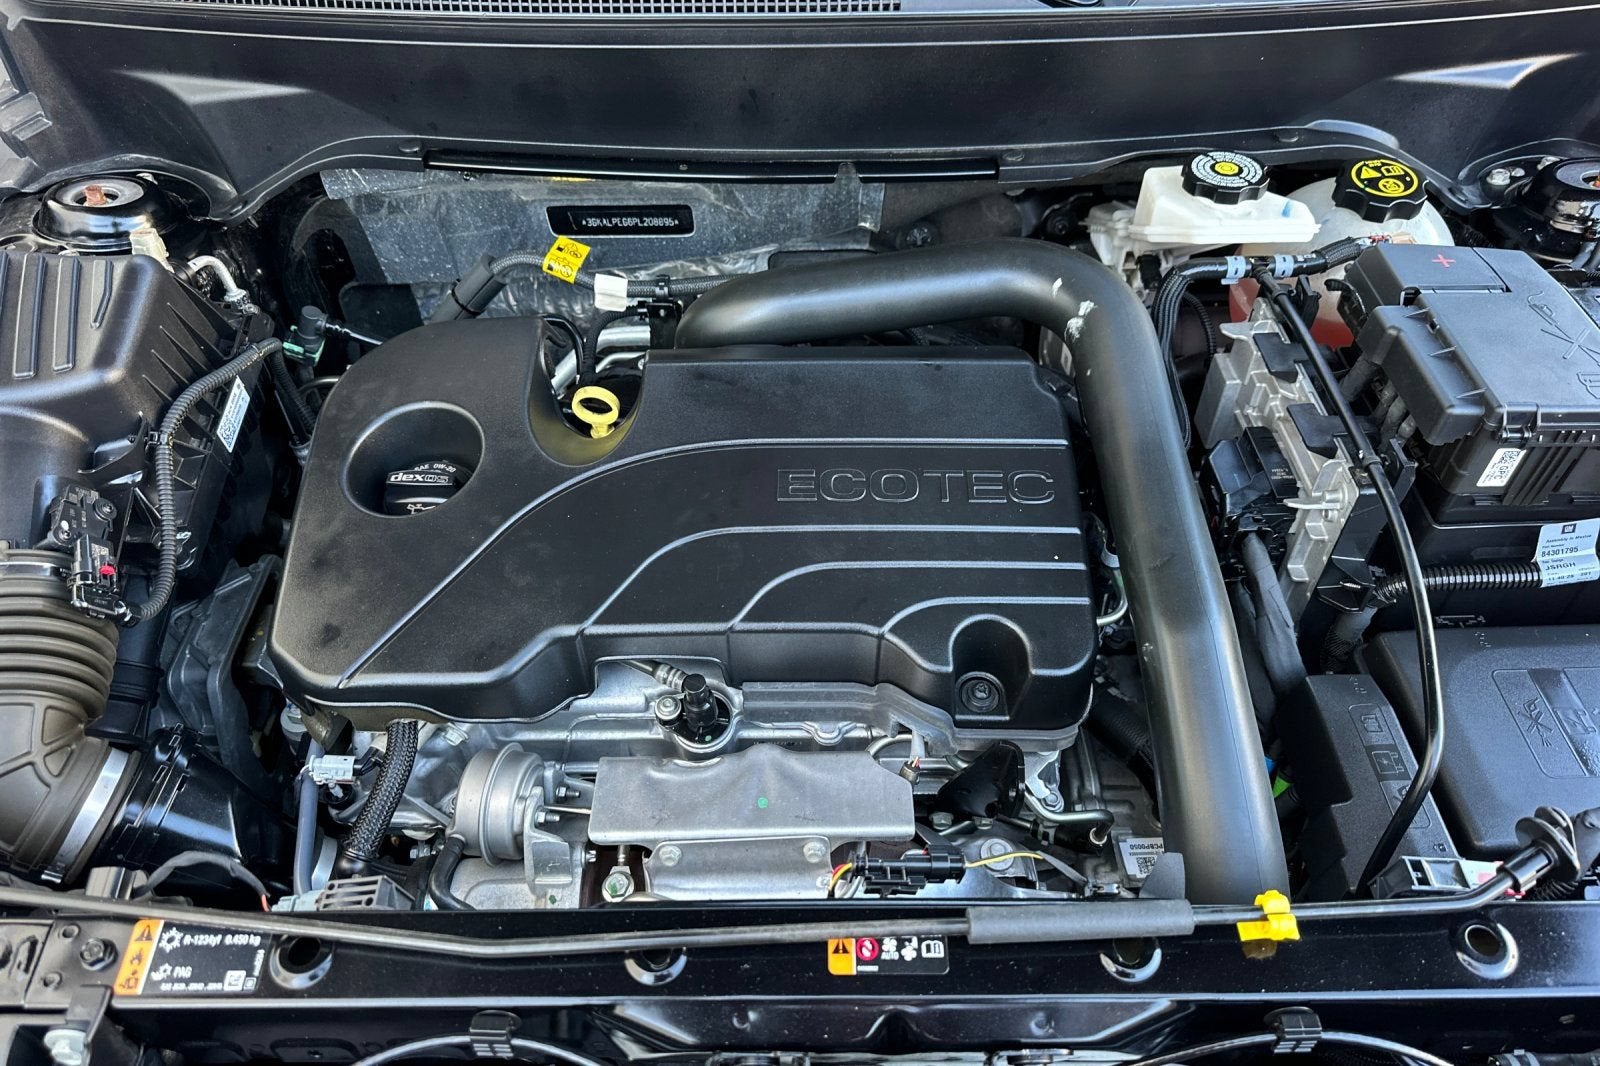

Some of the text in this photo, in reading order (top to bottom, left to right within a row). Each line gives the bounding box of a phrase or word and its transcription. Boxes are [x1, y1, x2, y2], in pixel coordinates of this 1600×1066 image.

[433, 463, 456, 473] 0W-20
[390, 472, 449, 483] dexos
[777, 468, 1056, 504] ECOTEC
[1541, 546, 1579, 558] 84301795
[880, 951, 899, 961] AUTO
